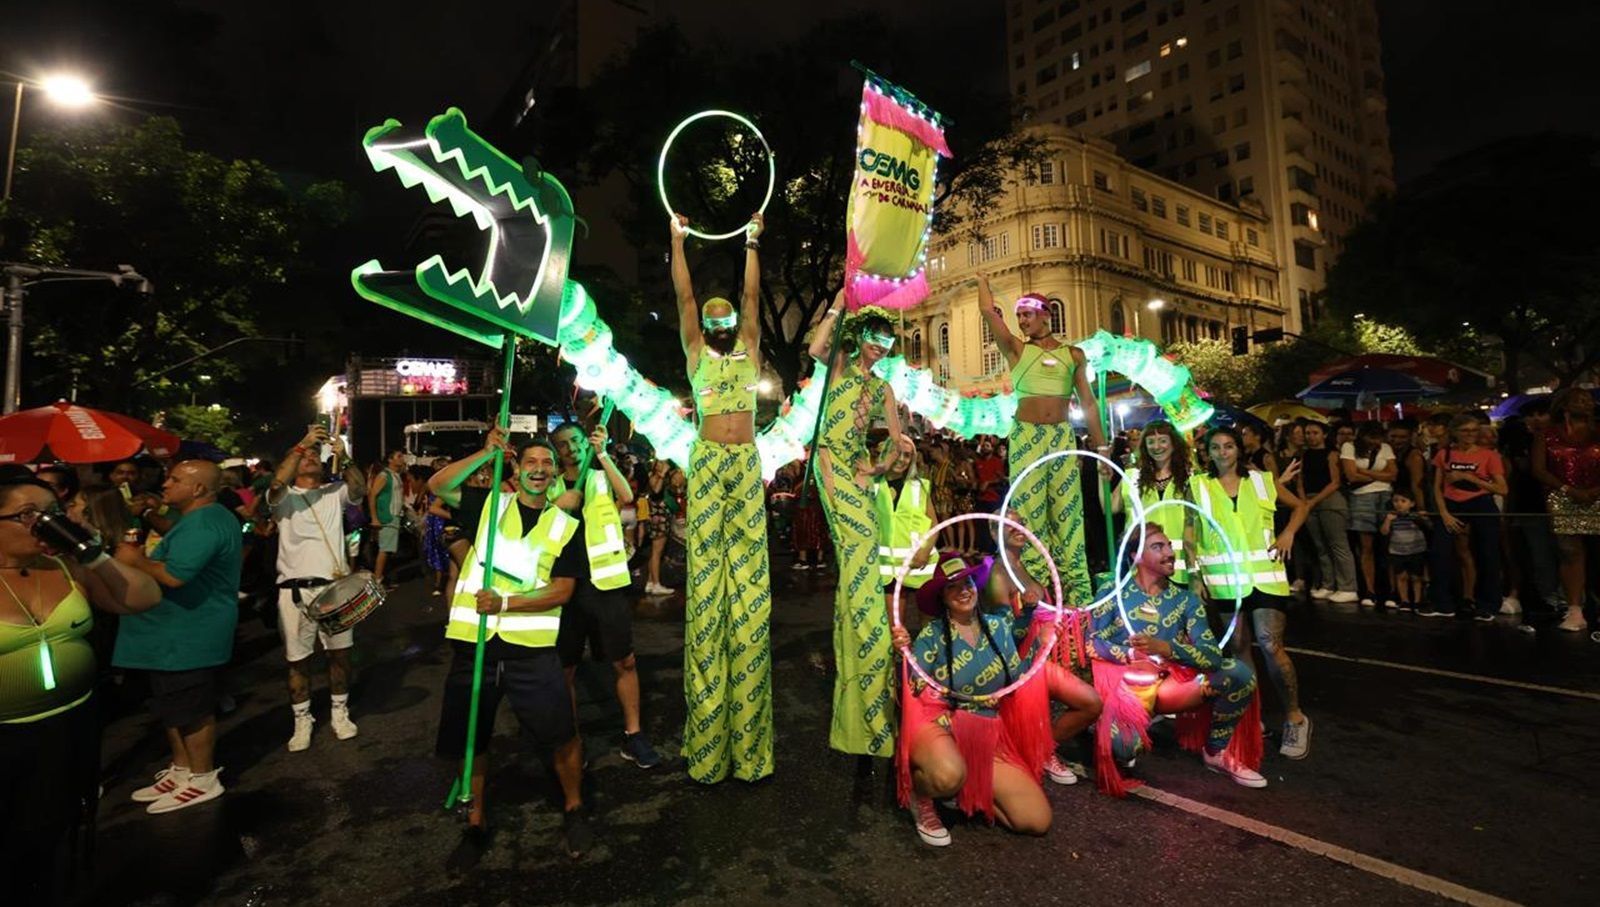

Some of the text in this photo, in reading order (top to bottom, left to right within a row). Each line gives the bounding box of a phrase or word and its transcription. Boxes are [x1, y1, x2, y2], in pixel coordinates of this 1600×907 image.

[861, 178, 869, 187] A
[828, 380, 853, 404] EMIG
[826, 409, 845, 431] MIG
[693, 501, 720, 529] CEMIG
[694, 558, 719, 586] CEMIG
[858, 626, 883, 659] CEMIG
[697, 675, 720, 704] CEMIG
[864, 688, 890, 723] CEMIG
[695, 734, 721, 762] CEMIG
